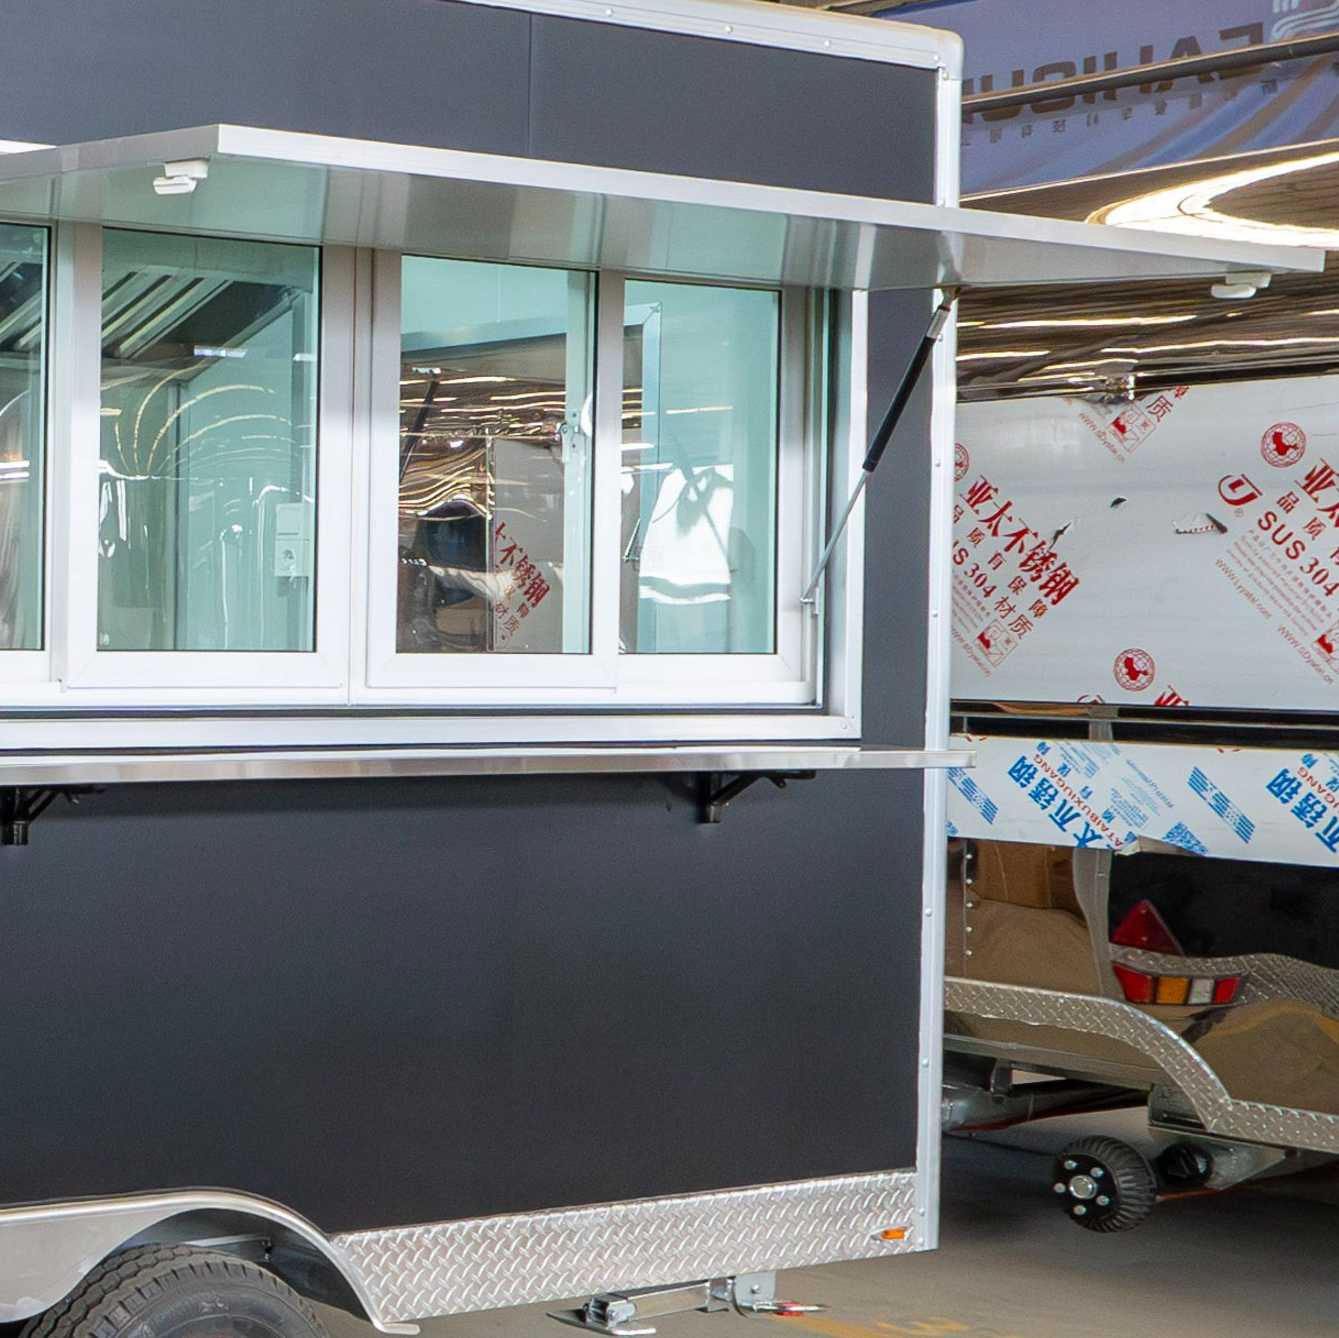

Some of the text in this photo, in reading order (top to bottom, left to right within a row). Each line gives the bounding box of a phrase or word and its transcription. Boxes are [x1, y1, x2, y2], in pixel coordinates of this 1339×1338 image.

[959, 474, 1080, 606] 亚太不锈钢
[1257, 510, 1306, 561] SUS
[1299, 556, 1339, 597] 304
[963, 562, 998, 599] 304
[993, 595, 1034, 640] 材质
[1007, 755, 1113, 850] 太不锈钢
[1033, 753, 1124, 848] ATAIBUXIUGANG
